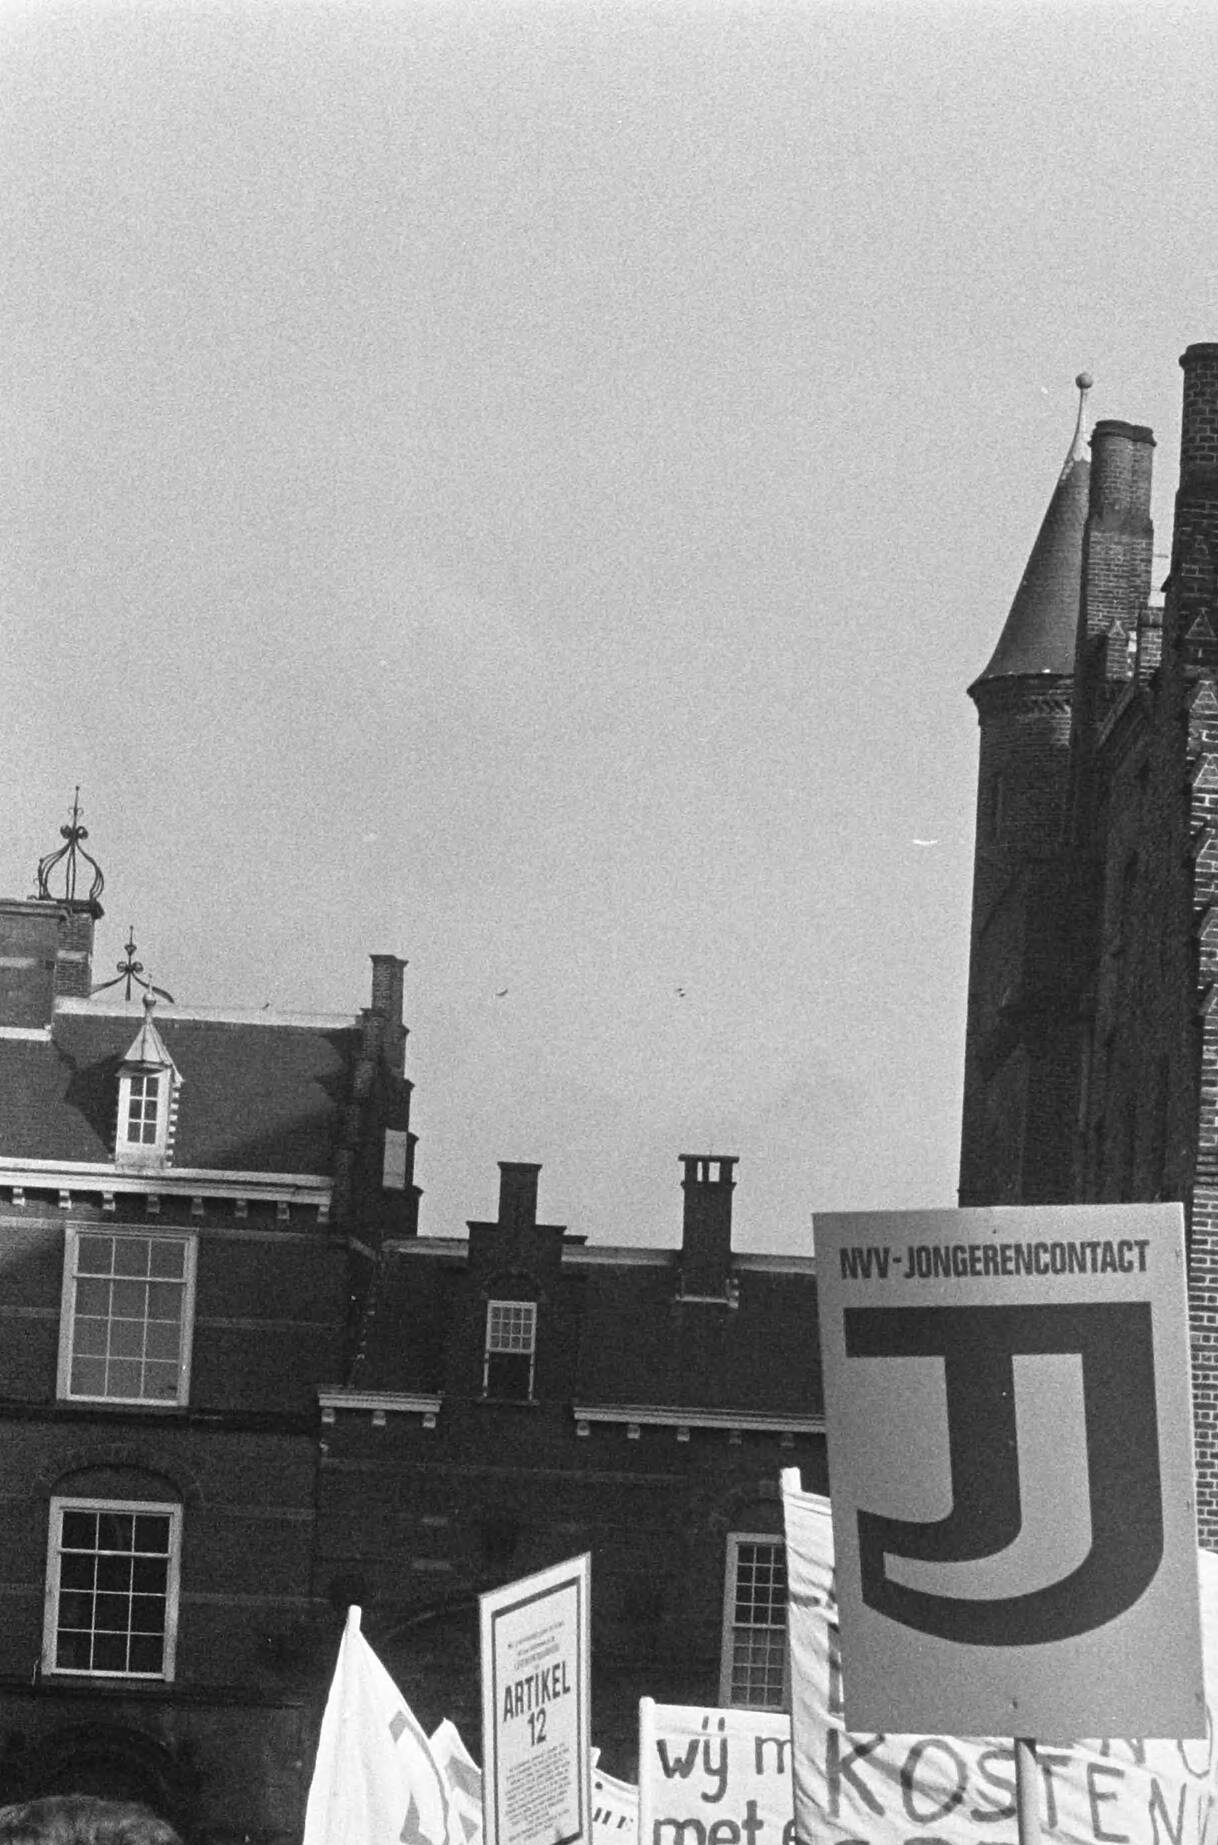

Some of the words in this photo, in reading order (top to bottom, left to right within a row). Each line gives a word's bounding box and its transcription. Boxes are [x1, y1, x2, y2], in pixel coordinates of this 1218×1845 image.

[840, 1239, 1151, 1279] NVV-JONGERENCONTACT
[503, 1661, 571, 1722] ARTIKEL
[527, 1707, 547, 1747] 12
